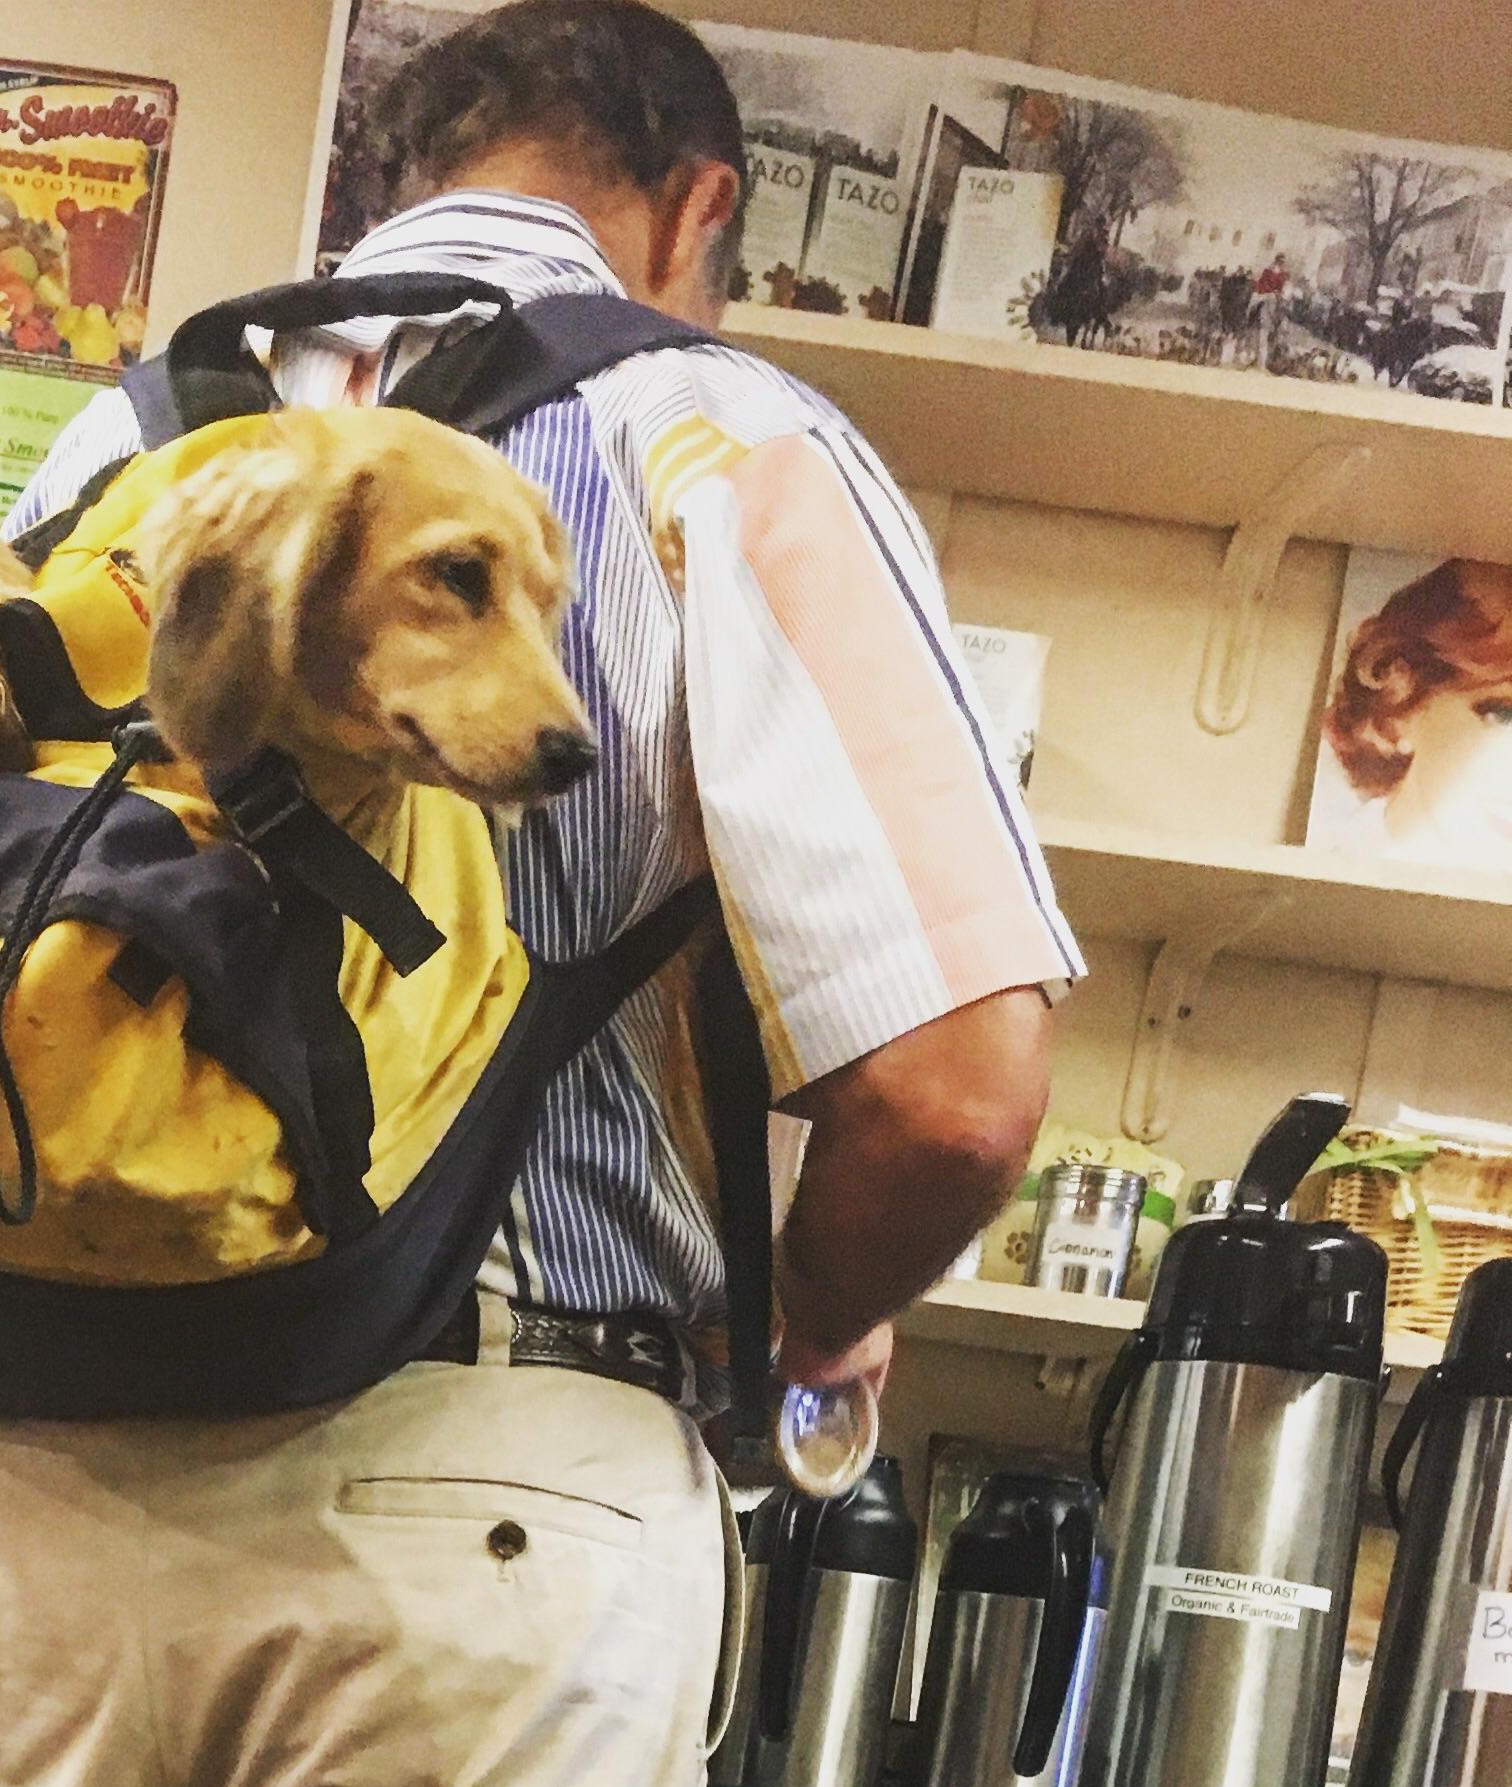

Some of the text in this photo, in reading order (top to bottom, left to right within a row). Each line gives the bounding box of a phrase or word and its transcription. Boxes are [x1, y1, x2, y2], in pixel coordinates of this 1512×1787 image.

[19, 95, 168, 146] Smoothie
[837, 178, 900, 215] TAZO
[968, 176, 1015, 195] TAZO
[962, 633, 1006, 653] TAZO
[1184, 1573, 1299, 1600] FRENCH ROAST
[1172, 1594, 1295, 1623] Organic & Fairtrade
